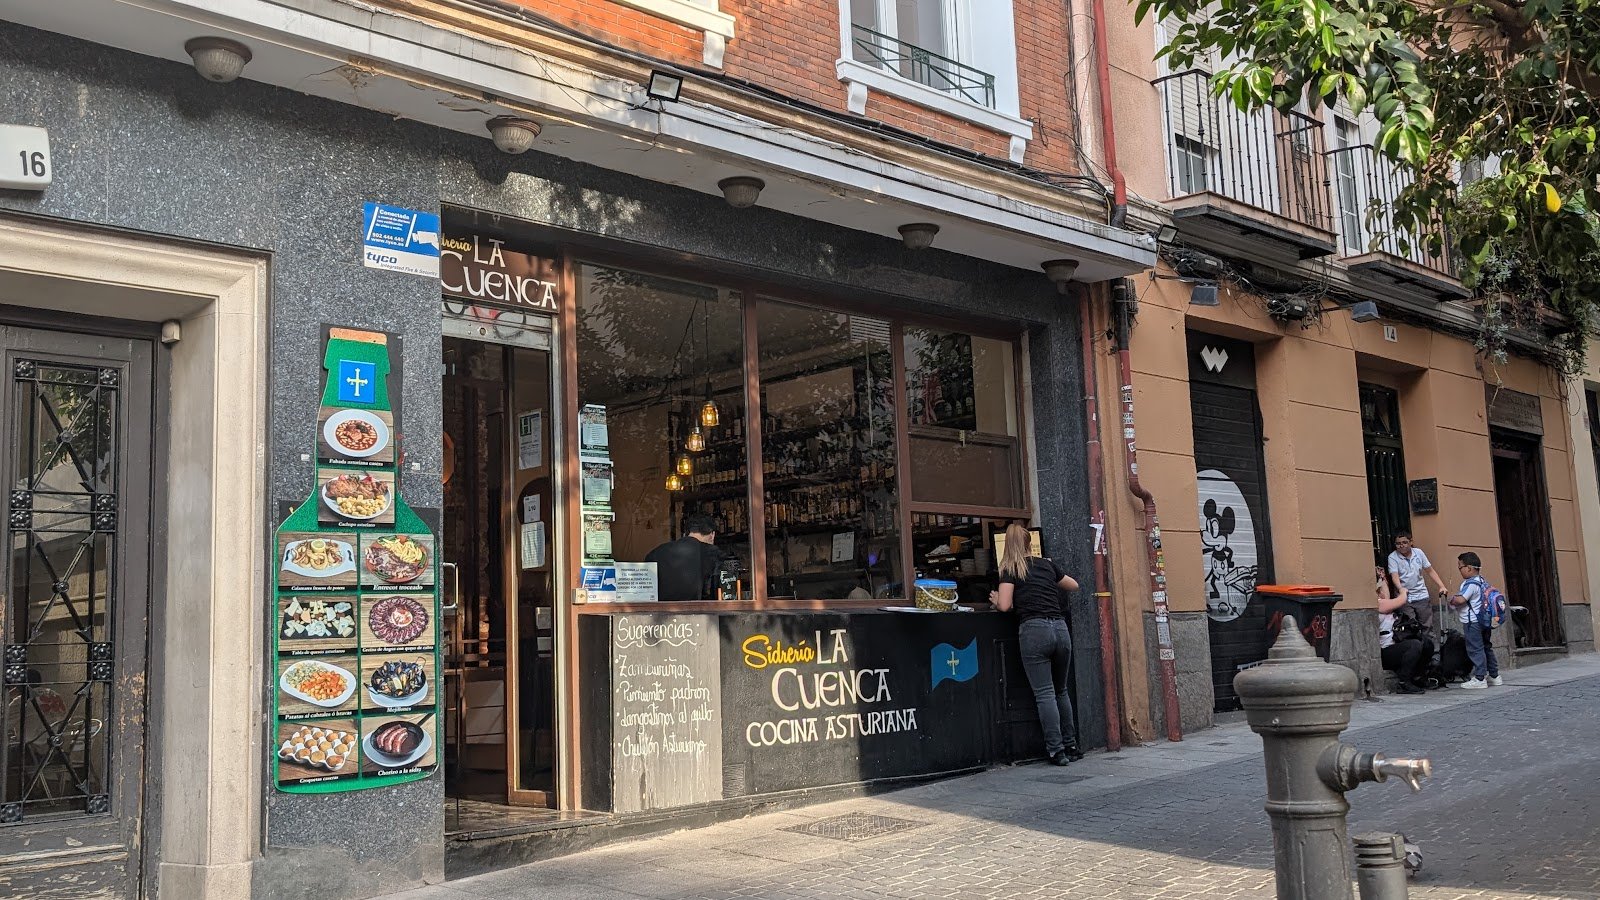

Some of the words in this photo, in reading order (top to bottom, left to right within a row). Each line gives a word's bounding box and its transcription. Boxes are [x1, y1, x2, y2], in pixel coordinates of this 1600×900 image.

[20, 150, 46, 177] 16
[366, 251, 398, 264] tyco
[473, 235, 506, 267] LA
[441, 249, 557, 309] CUENCA
[1386, 326, 1396, 340] 14
[617, 616, 701, 647] Sugerencias:
[742, 634, 815, 669] Sidrería
[815, 629, 848, 665] LA
[618, 654, 694, 680] Zamburiñas
[771, 668, 892, 711] CUENCA
[679, 702, 687, 724] al
[746, 717, 819, 747] COCINA
[825, 708, 918, 741] ASTURIANA
